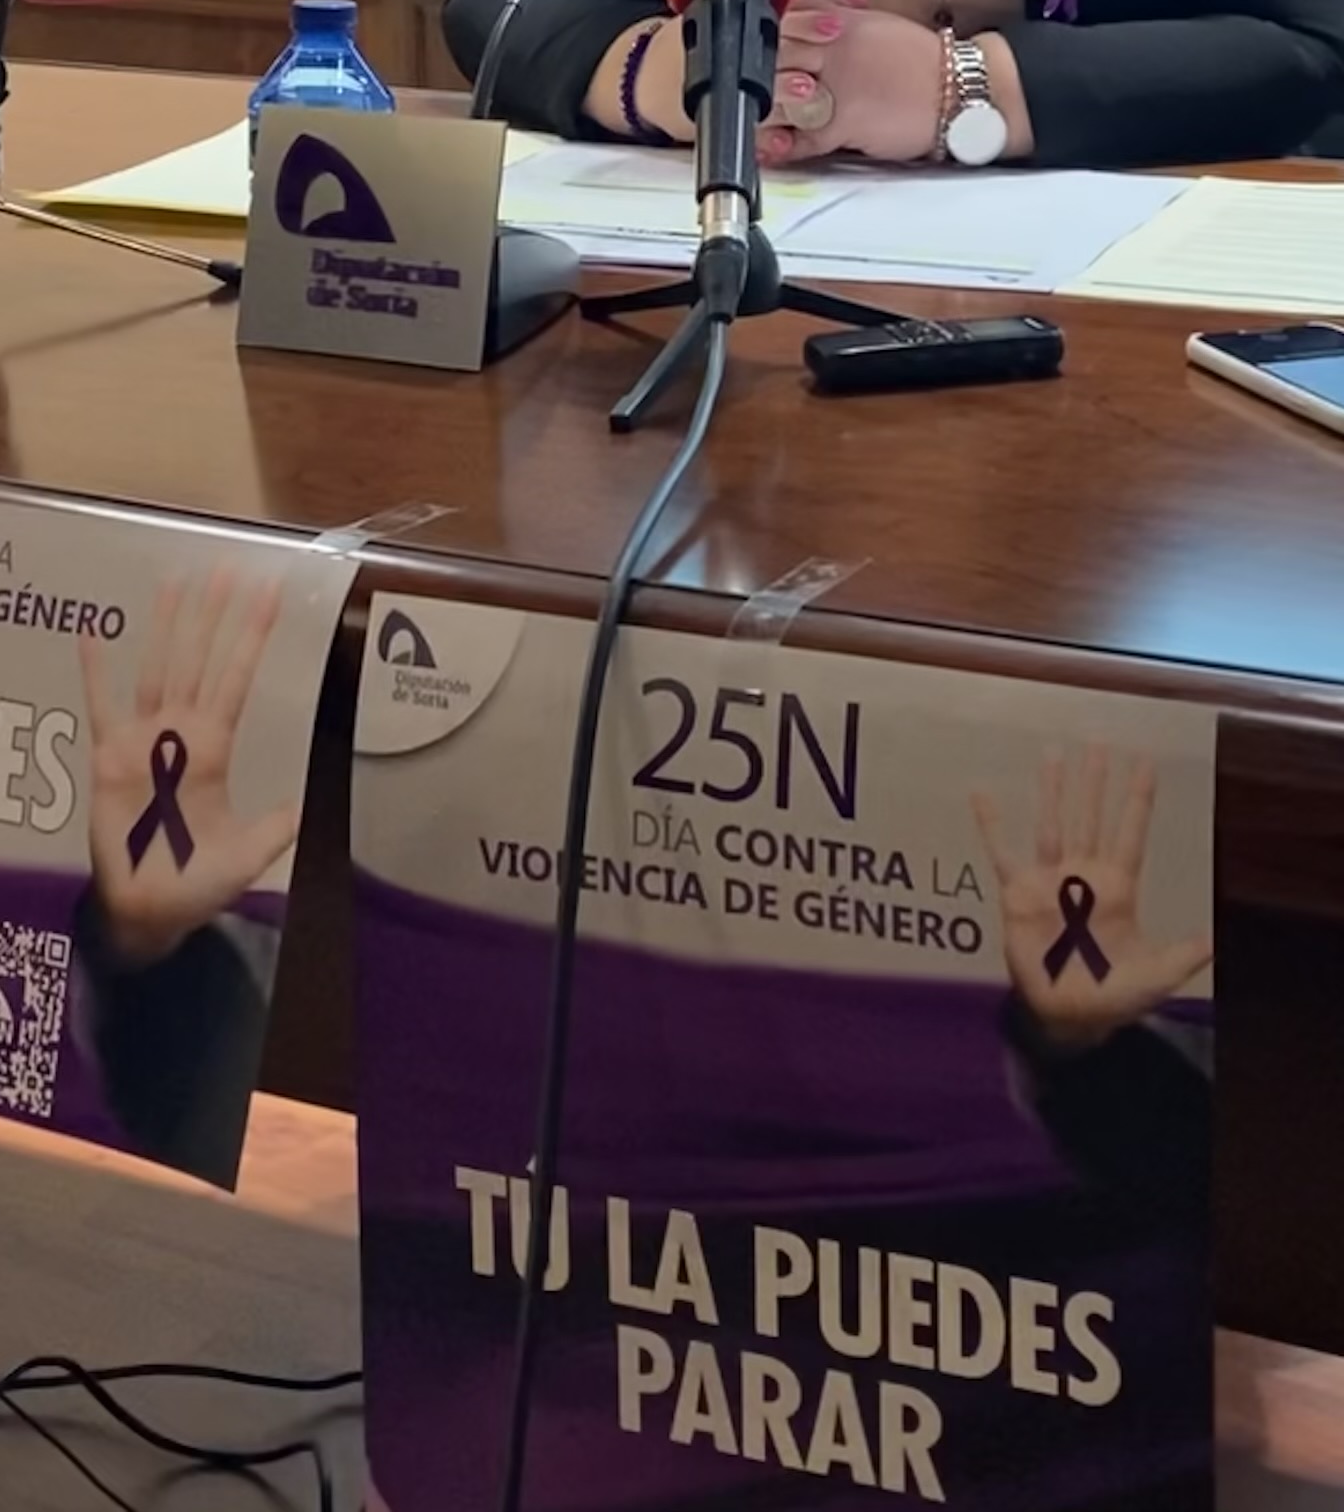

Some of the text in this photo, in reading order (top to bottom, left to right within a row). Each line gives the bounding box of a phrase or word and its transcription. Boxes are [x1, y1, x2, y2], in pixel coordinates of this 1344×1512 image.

[307, 278, 419, 319] de Soria
[312, 248, 461, 289] Diputación
[392, 688, 449, 710] de Soria
[395, 670, 472, 696] Diputación
[632, 677, 861, 821] 25N
[479, 836, 983, 957] VIOENCIA DE GÉNERO
[631, 807, 984, 902] DÍA CONTRA LA
[607, 1195, 720, 1326] LA
[753, 1224, 1123, 1409] PUEDES
[617, 1323, 946, 1503] PARAR
